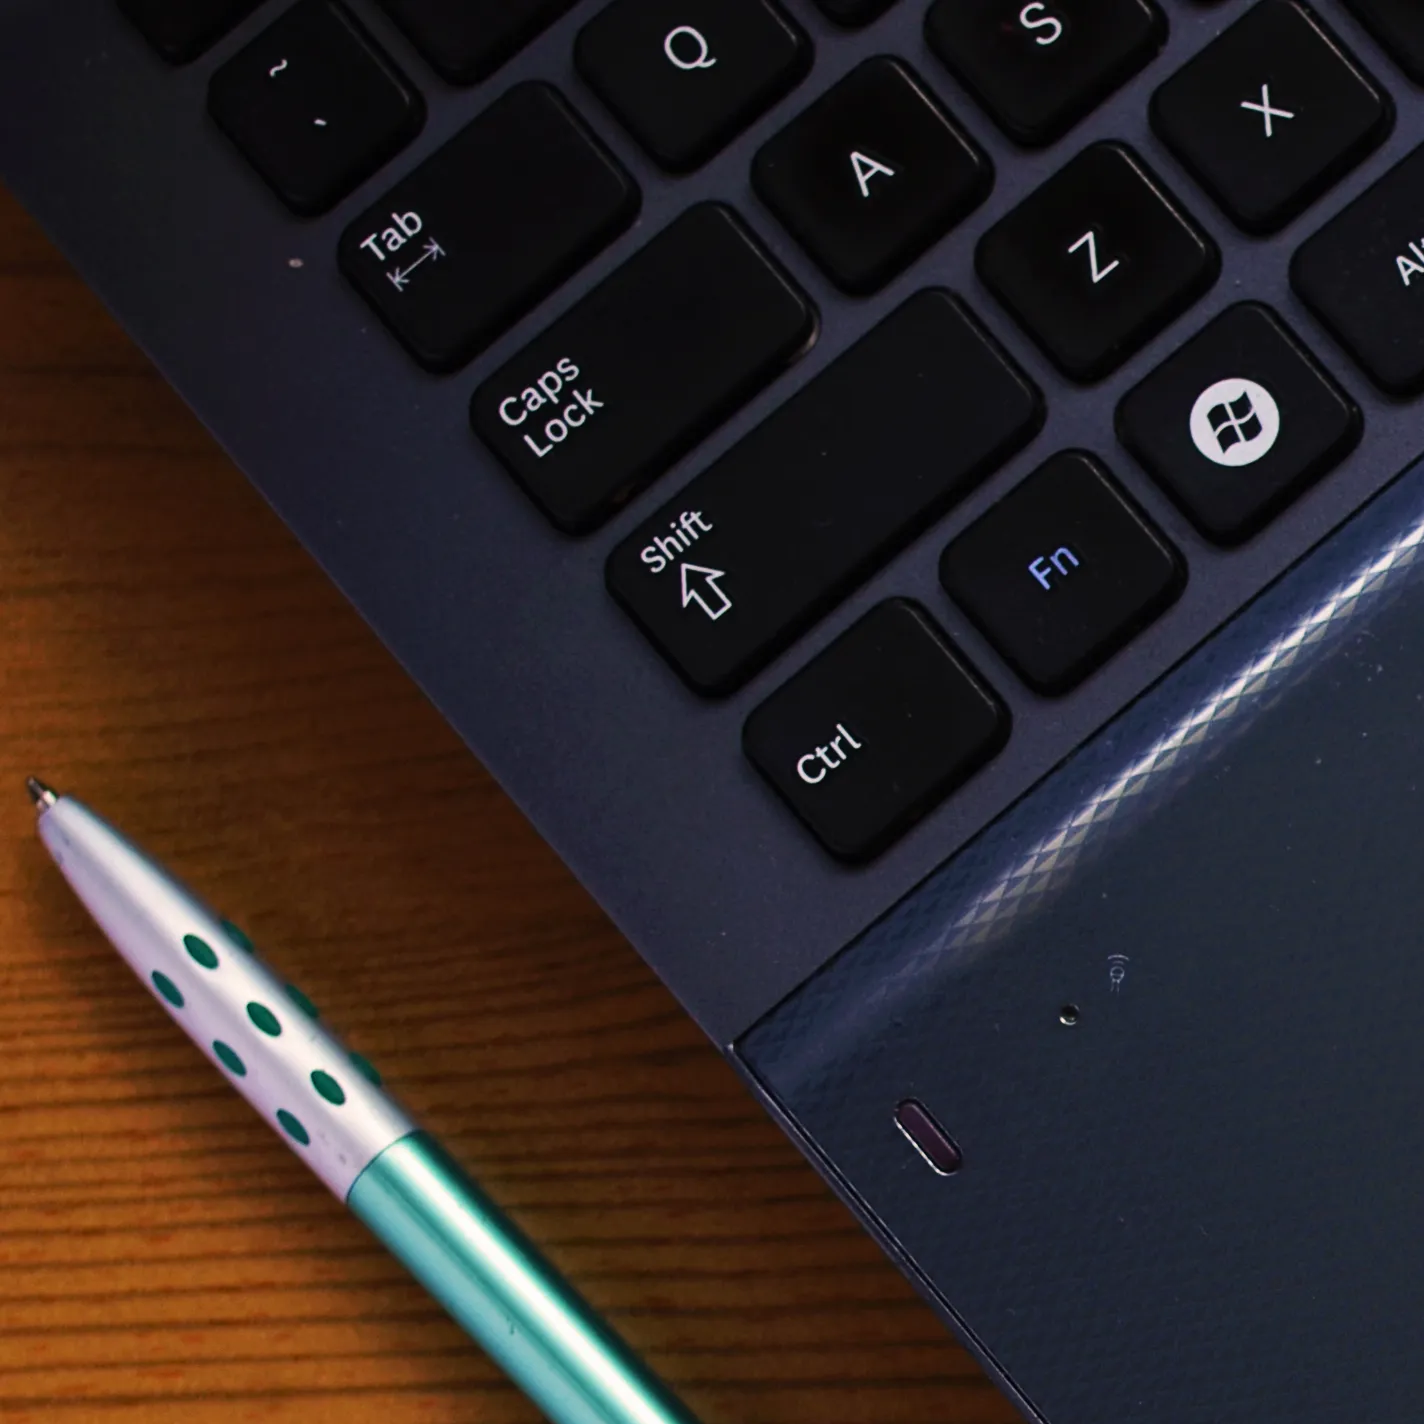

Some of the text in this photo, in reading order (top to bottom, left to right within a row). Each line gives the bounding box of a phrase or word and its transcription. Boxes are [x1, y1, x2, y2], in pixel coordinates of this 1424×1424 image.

[663, 25, 718, 71] Q
[1018, 0, 1064, 47] S
[1240, 83, 1296, 138] X
[849, 151, 896, 198] A
[359, 211, 424, 261] Tab
[1067, 230, 1120, 285] Z
[498, 357, 581, 427] Caps
[523, 388, 606, 459] Lock
[640, 510, 714, 575] Shift
[1028, 545, 1082, 591] Fn
[796, 723, 864, 785] Ctrl
